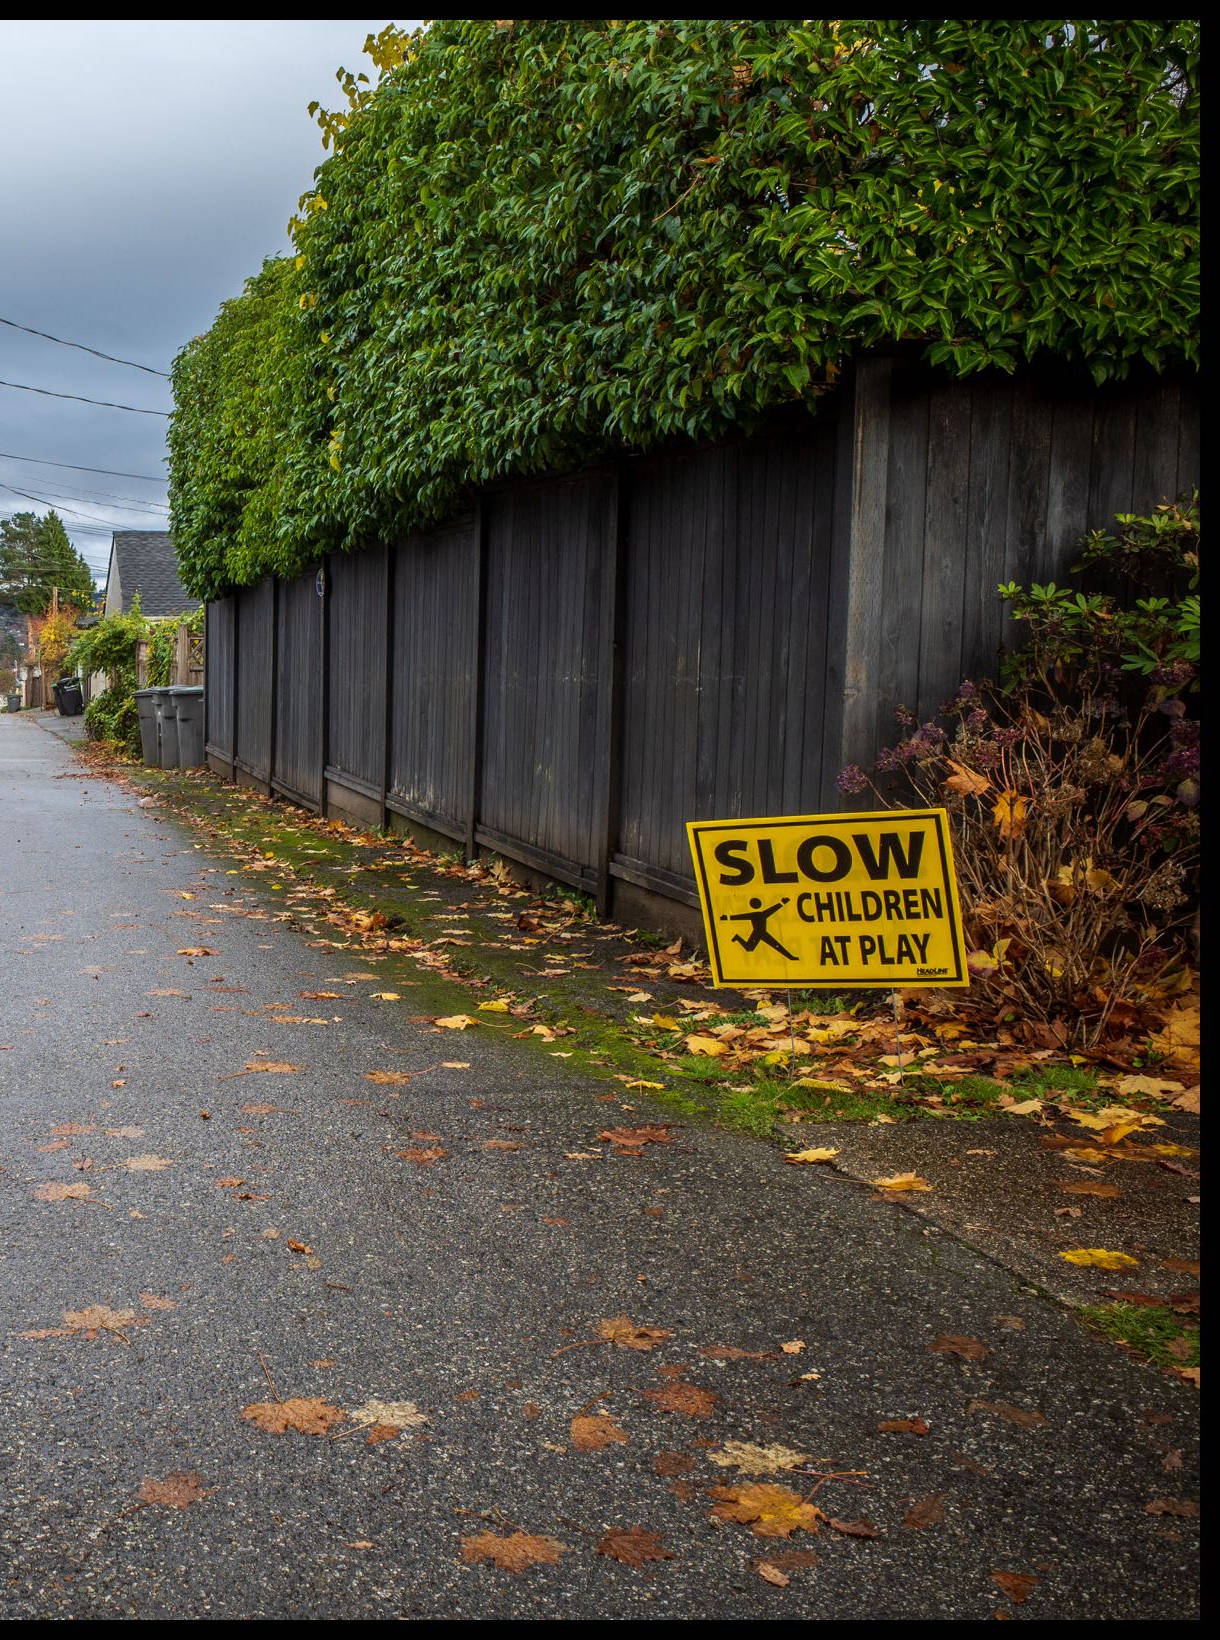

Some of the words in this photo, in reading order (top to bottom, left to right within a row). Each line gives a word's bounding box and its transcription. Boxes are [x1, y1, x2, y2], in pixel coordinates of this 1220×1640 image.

[714, 831, 925, 886] SLOW
[797, 888, 944, 922] CHILDREN
[820, 935, 851, 966] AT
[859, 933, 930, 965] PLAY
